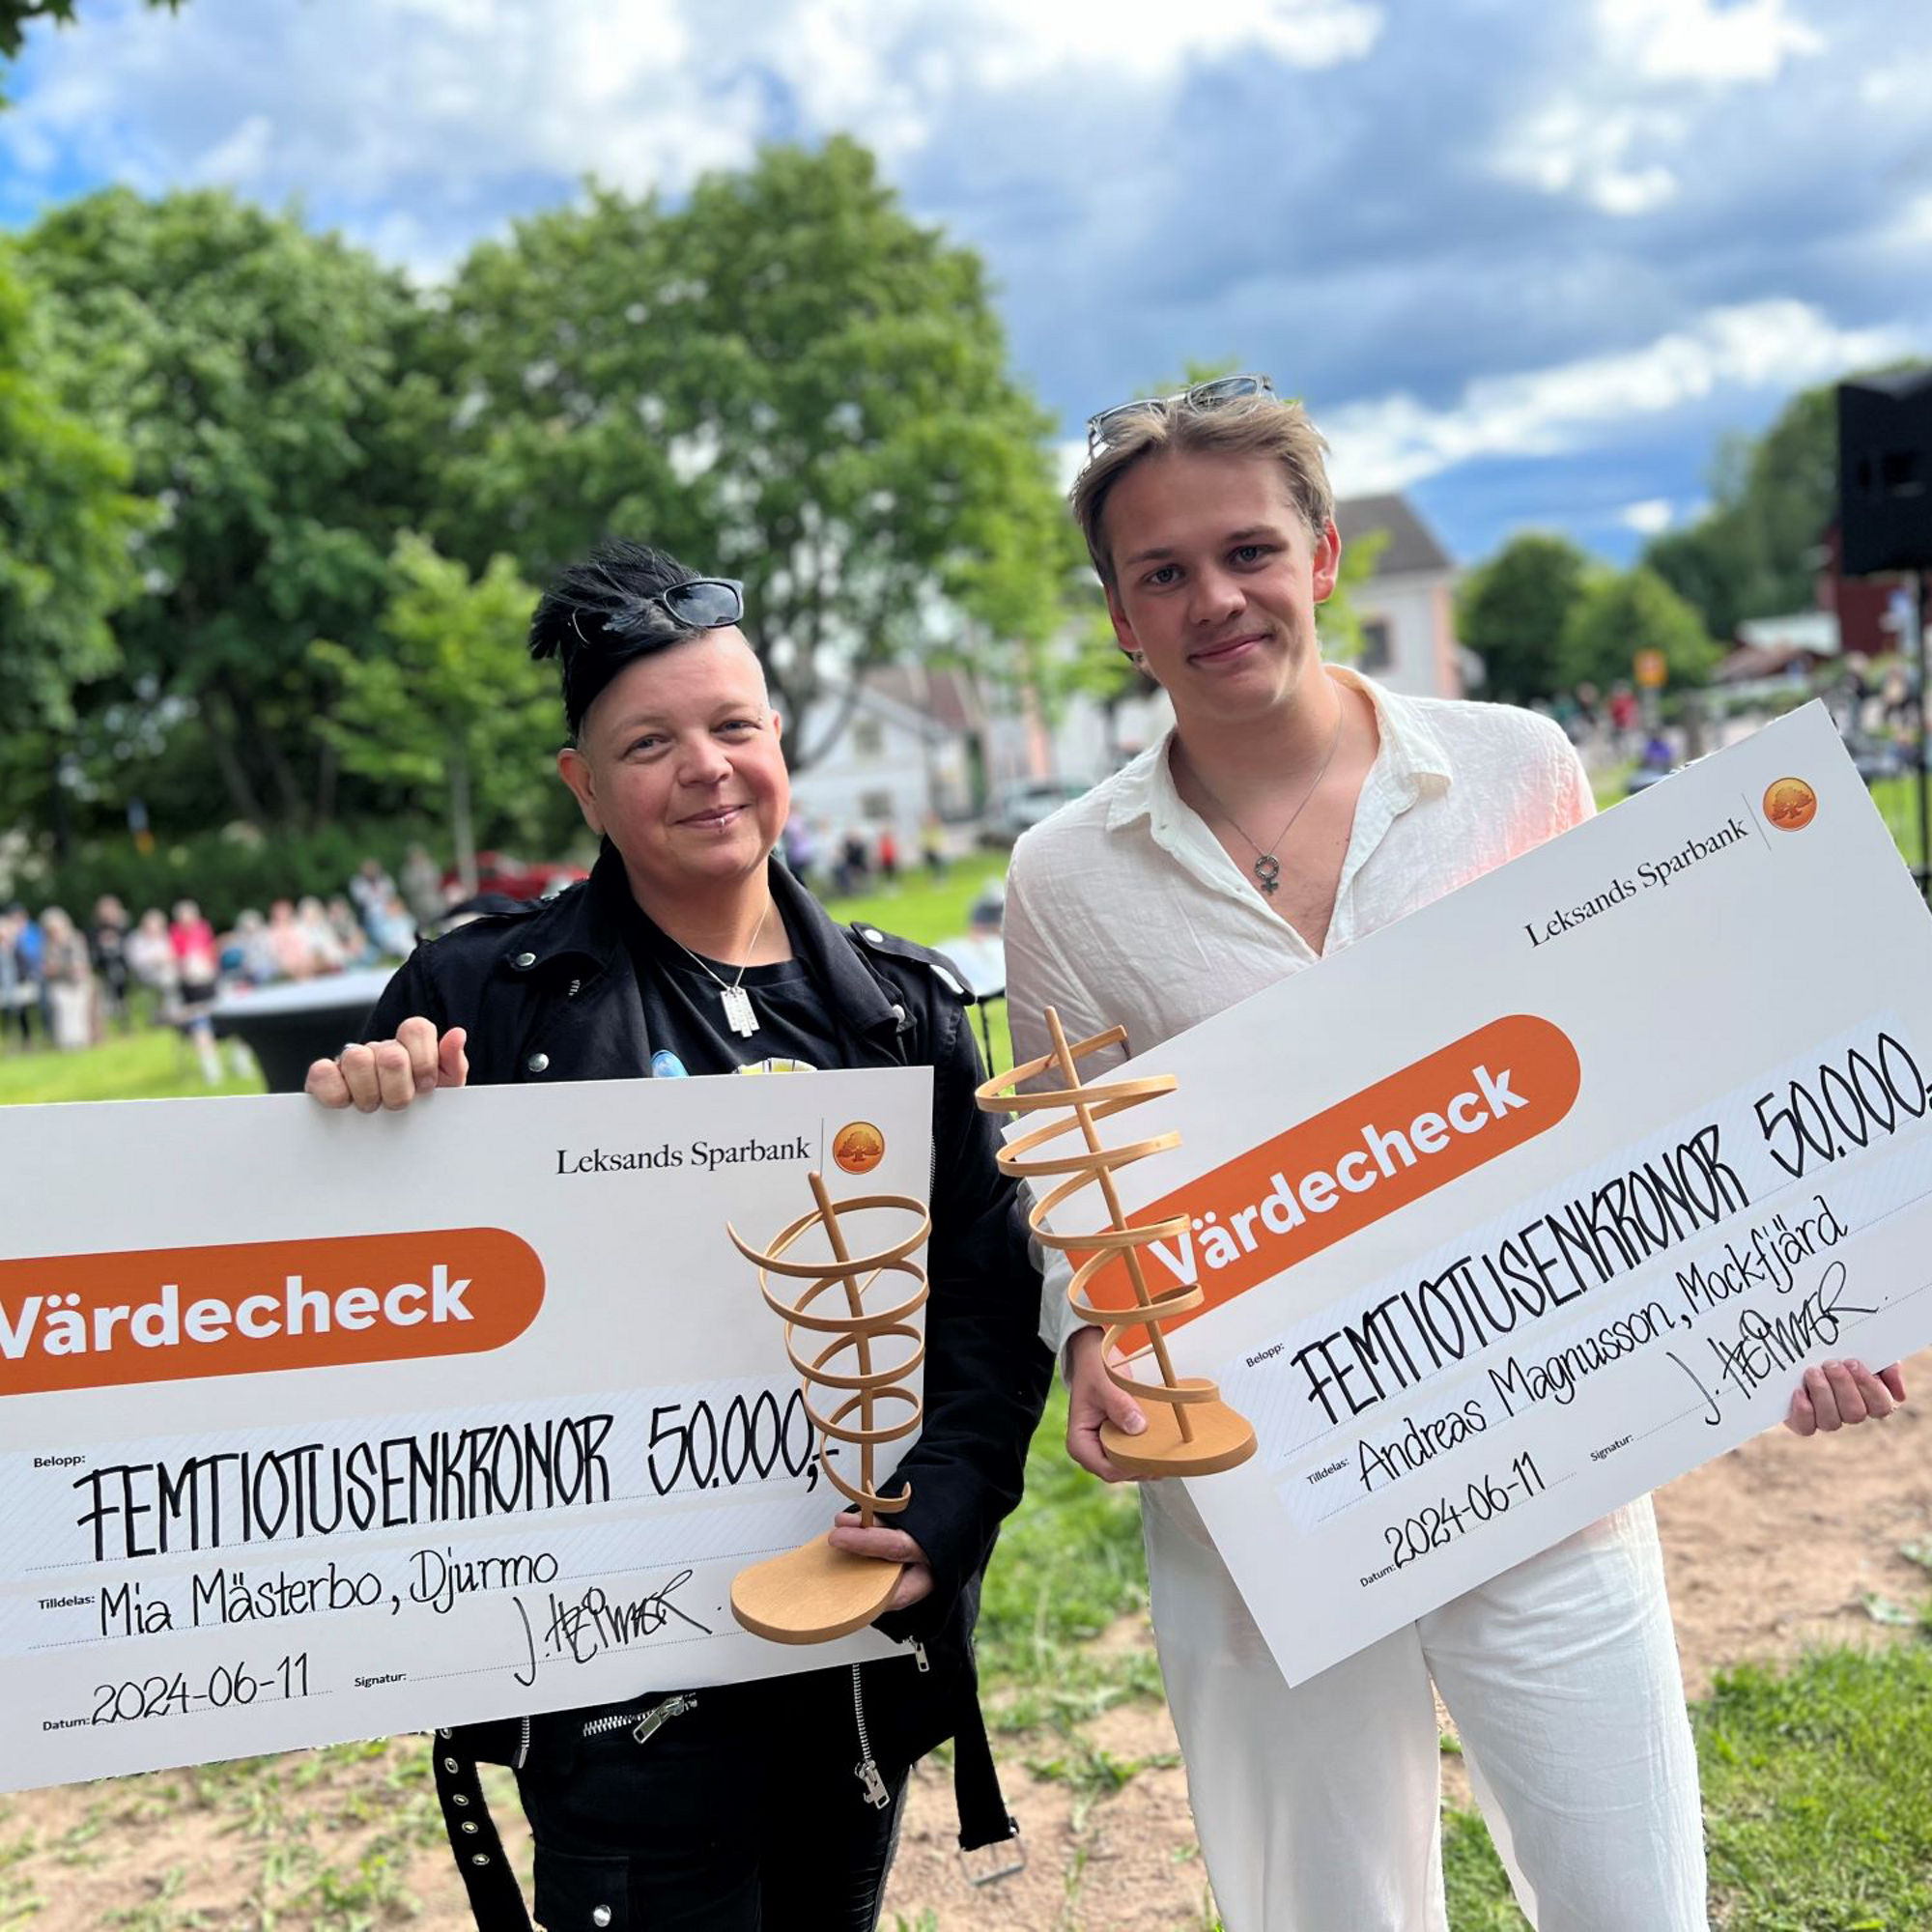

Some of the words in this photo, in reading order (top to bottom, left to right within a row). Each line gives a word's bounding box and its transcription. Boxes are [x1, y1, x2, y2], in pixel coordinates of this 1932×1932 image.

[1524, 879, 1637, 948] Leksands
[1637, 817, 1749, 888] Sparbank
[556, 1144, 683, 1175] Leksands
[691, 1137, 811, 1172] Sparbank
[1148, 1065, 1530, 1286] Värdecheck
[1291, 1124, 1749, 1425] FEMTIOTUSENKRONOR
[1754, 1033, 1932, 1179] 50.000
[0, 1264, 475, 1359] Värdecheck
[1246, 1343, 1285, 1368] Belopp:
[34, 1453, 86, 1469] Belopp:
[1306, 1459, 1350, 1486] Tilldelas:
[1359, 1400, 1488, 1492] Andreas
[1590, 1435, 1634, 1462] Signatur:
[72, 1414, 614, 1562] FEMTIOTUSENKRONOR
[1384, 1451, 1546, 1569] 2024-06-11
[39, 1594, 96, 1610] Tilldelas:
[101, 1582, 174, 1636] Mia
[410, 1547, 558, 1614] Djurmo
[1359, 1562, 1397, 1588] Datum:
[91, 1653, 309, 1725] 2024-06-11
[355, 1674, 408, 1690] Signatur:
[43, 1718, 90, 1731] Datum:
